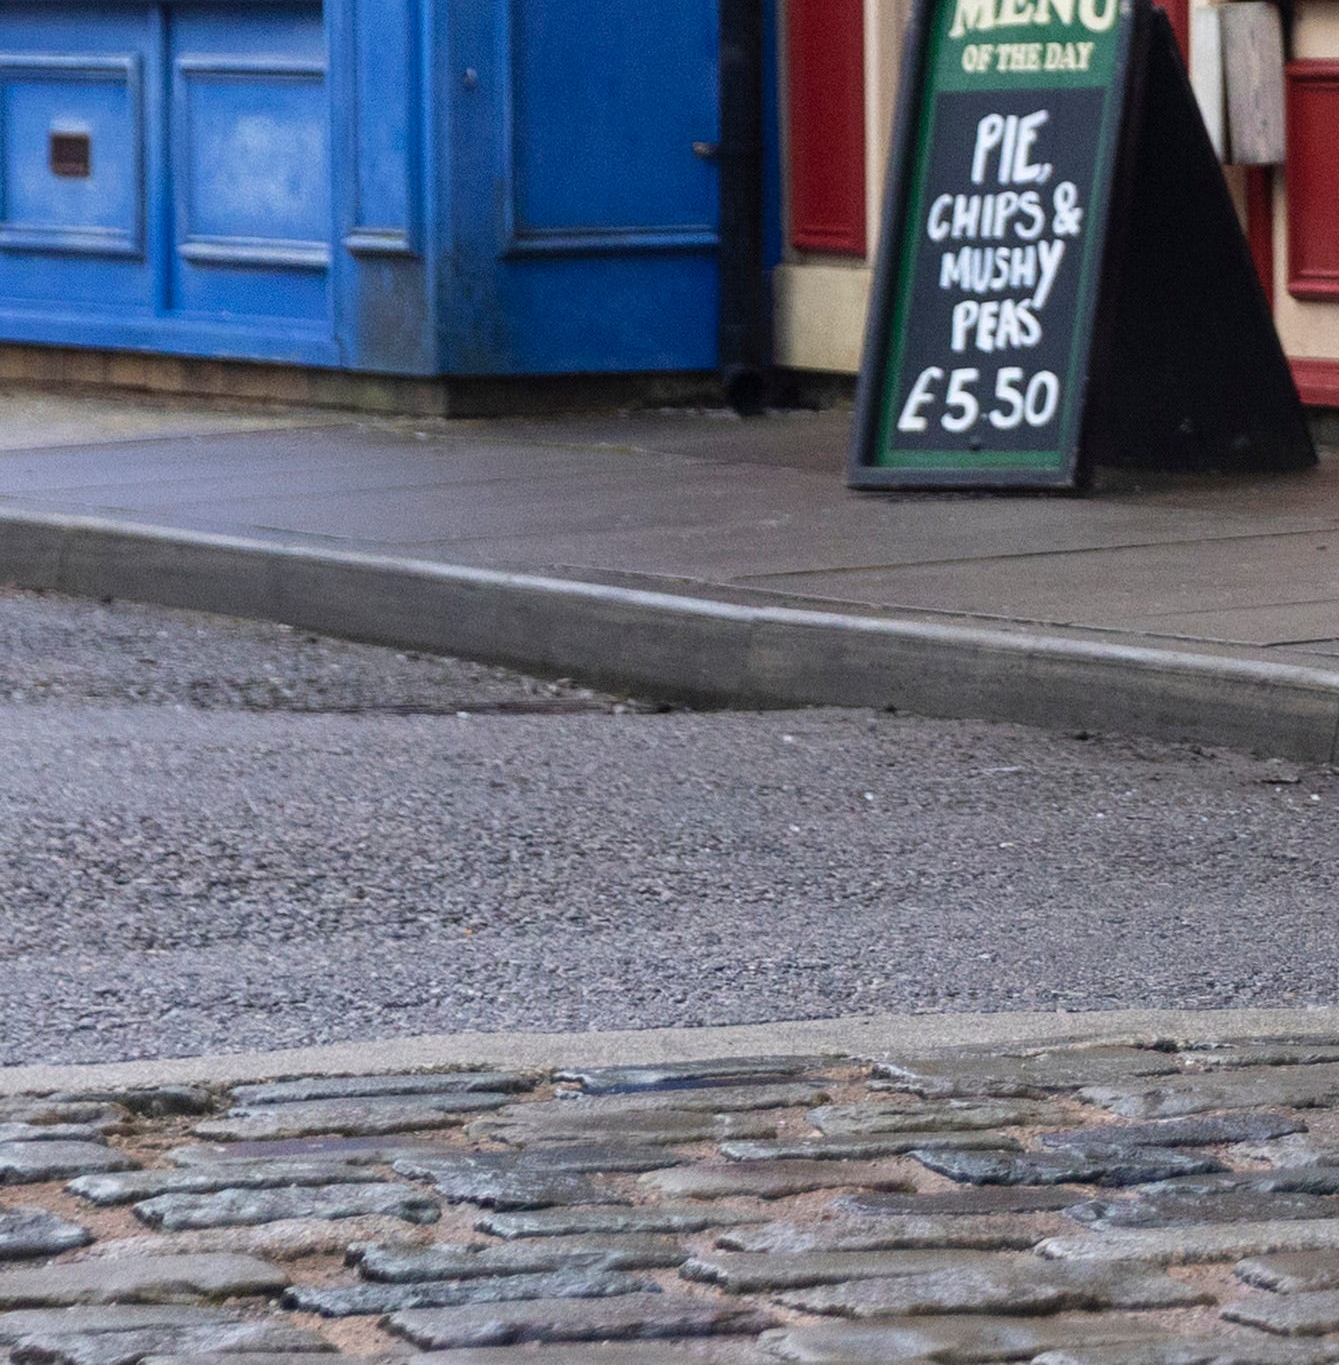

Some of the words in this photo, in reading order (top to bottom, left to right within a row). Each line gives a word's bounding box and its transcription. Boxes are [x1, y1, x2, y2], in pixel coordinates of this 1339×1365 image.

[961, 43, 993, 73] OF
[996, 42, 1043, 73] THE
[1043, 41, 1094, 72] DAY
[971, 109, 1053, 185] PIE,
[926, 191, 1046, 242] CHIPS
[1053, 181, 1084, 236] &
[939, 239, 1066, 309] MUSHY
[951, 298, 1042, 353] PEAS
[897, 366, 1060, 433] £5.50
